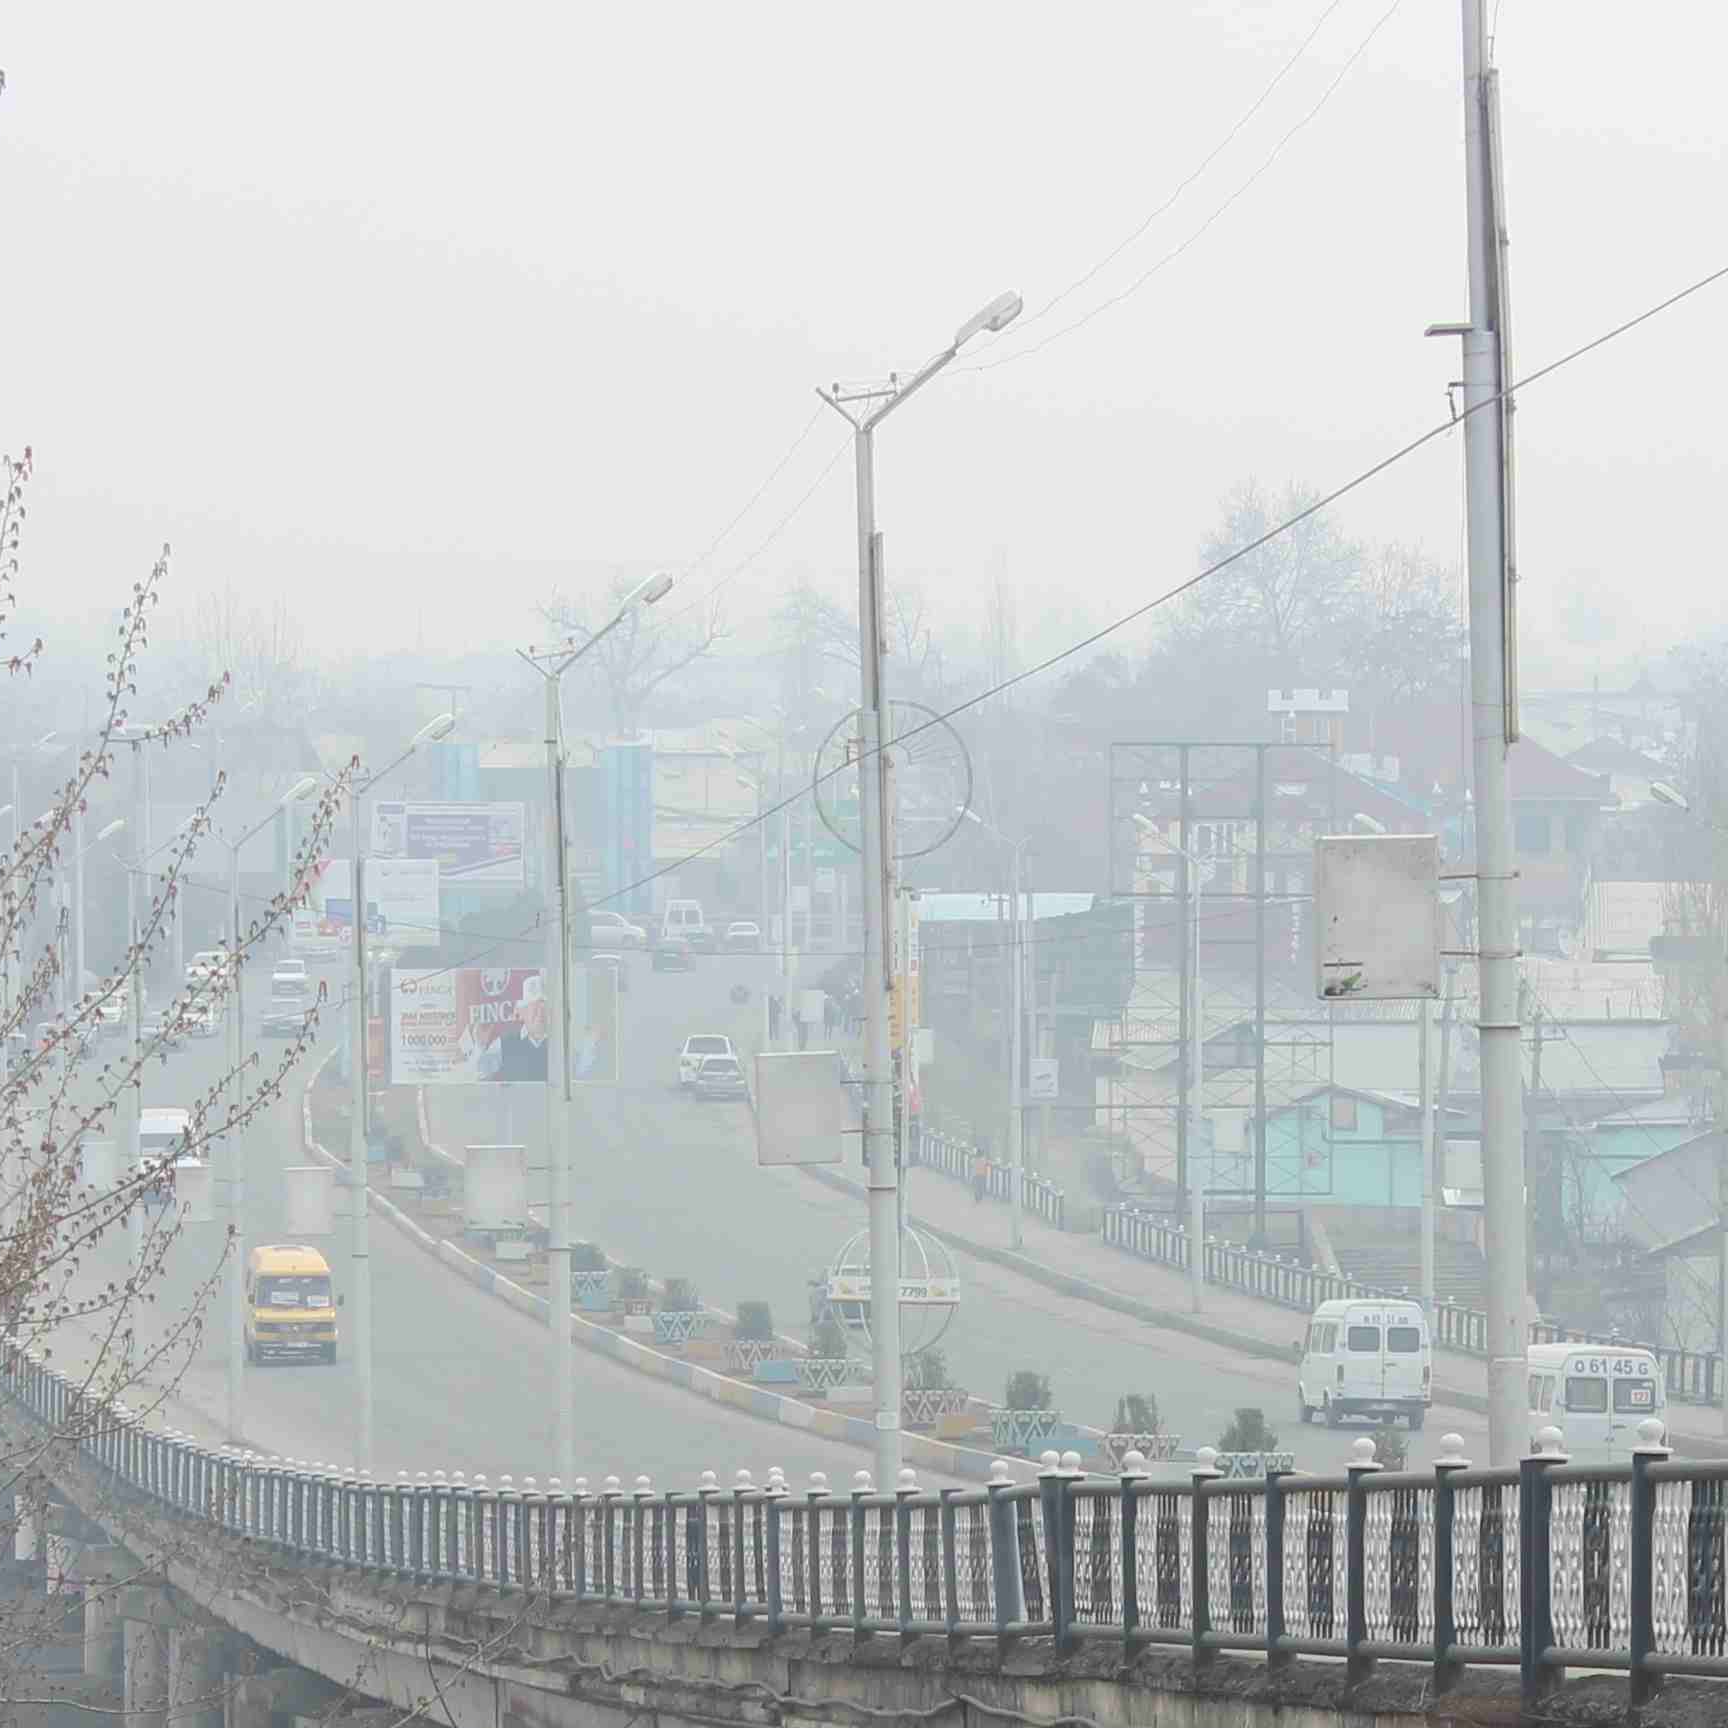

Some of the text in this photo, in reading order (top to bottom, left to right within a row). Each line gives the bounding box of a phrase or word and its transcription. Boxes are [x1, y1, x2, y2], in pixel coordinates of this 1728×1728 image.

[1589, 1358, 1607, 1374] 61
[1613, 1359, 1633, 1375] 45
[1638, 1362, 1649, 1375] G
